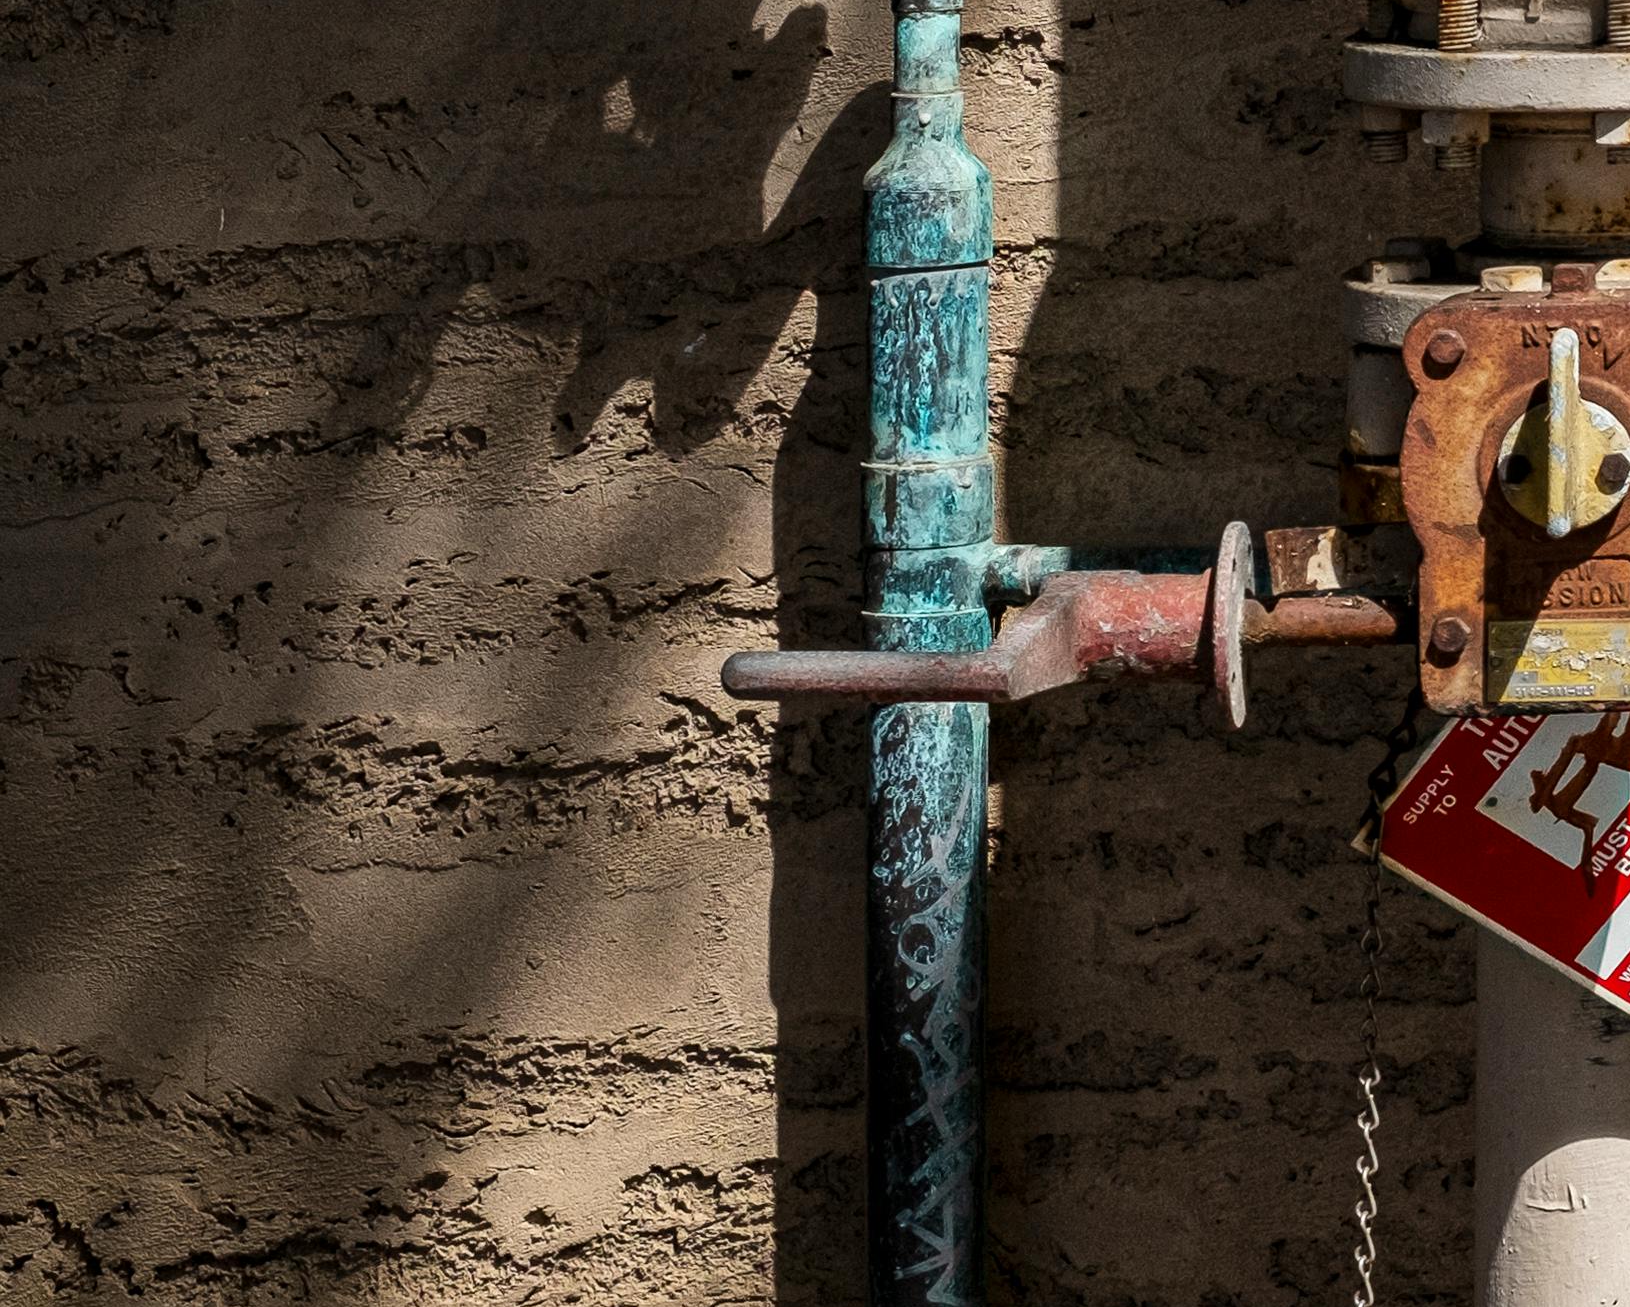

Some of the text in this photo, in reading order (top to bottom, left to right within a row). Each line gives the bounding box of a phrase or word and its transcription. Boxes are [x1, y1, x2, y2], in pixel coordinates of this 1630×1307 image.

[1520, 323, 1602, 350] OEN
[1401, 761, 1457, 828] SUPPLY
[1431, 790, 1459, 819] TO
